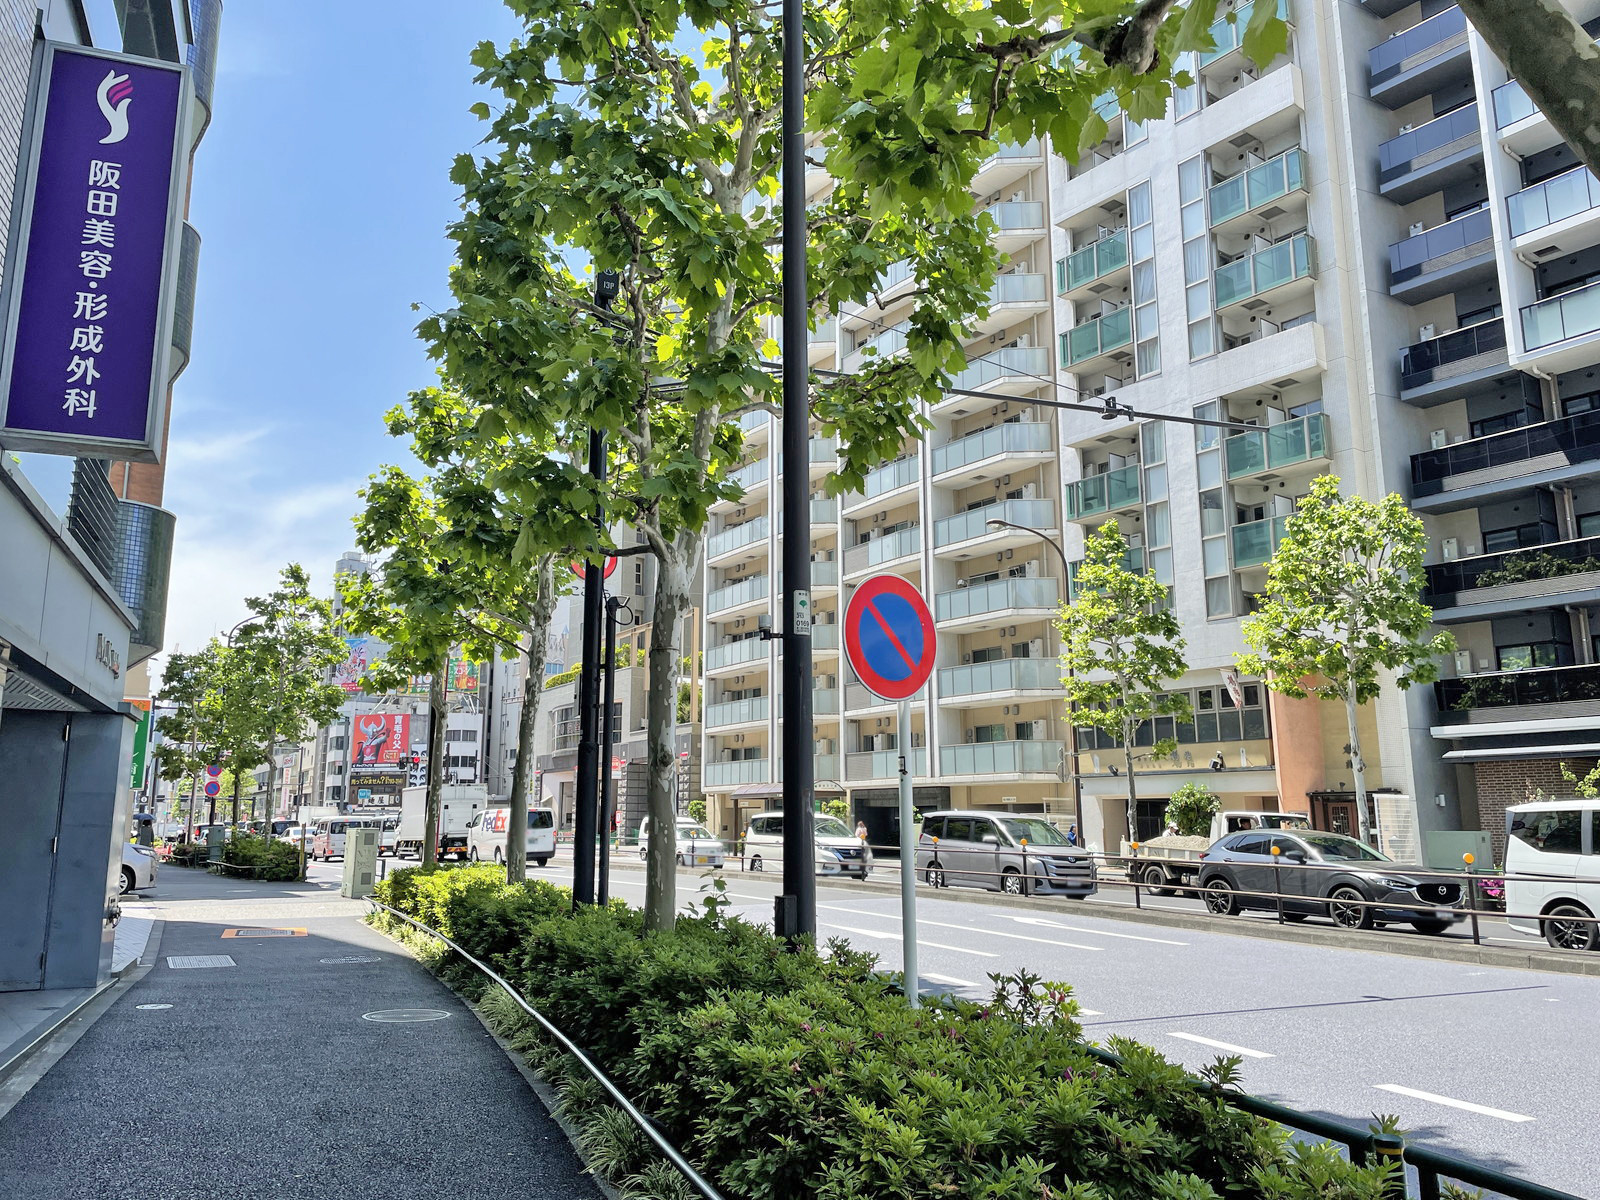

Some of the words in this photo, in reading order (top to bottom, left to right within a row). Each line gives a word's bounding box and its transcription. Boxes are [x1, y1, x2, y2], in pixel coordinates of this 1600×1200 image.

[62, 159, 123, 420] 阪田美容・形成外科
[572, 585, 611, 599] こら
[392, 715, 404, 750] 育毛の父
[482, 809, 507, 831] FedEx
